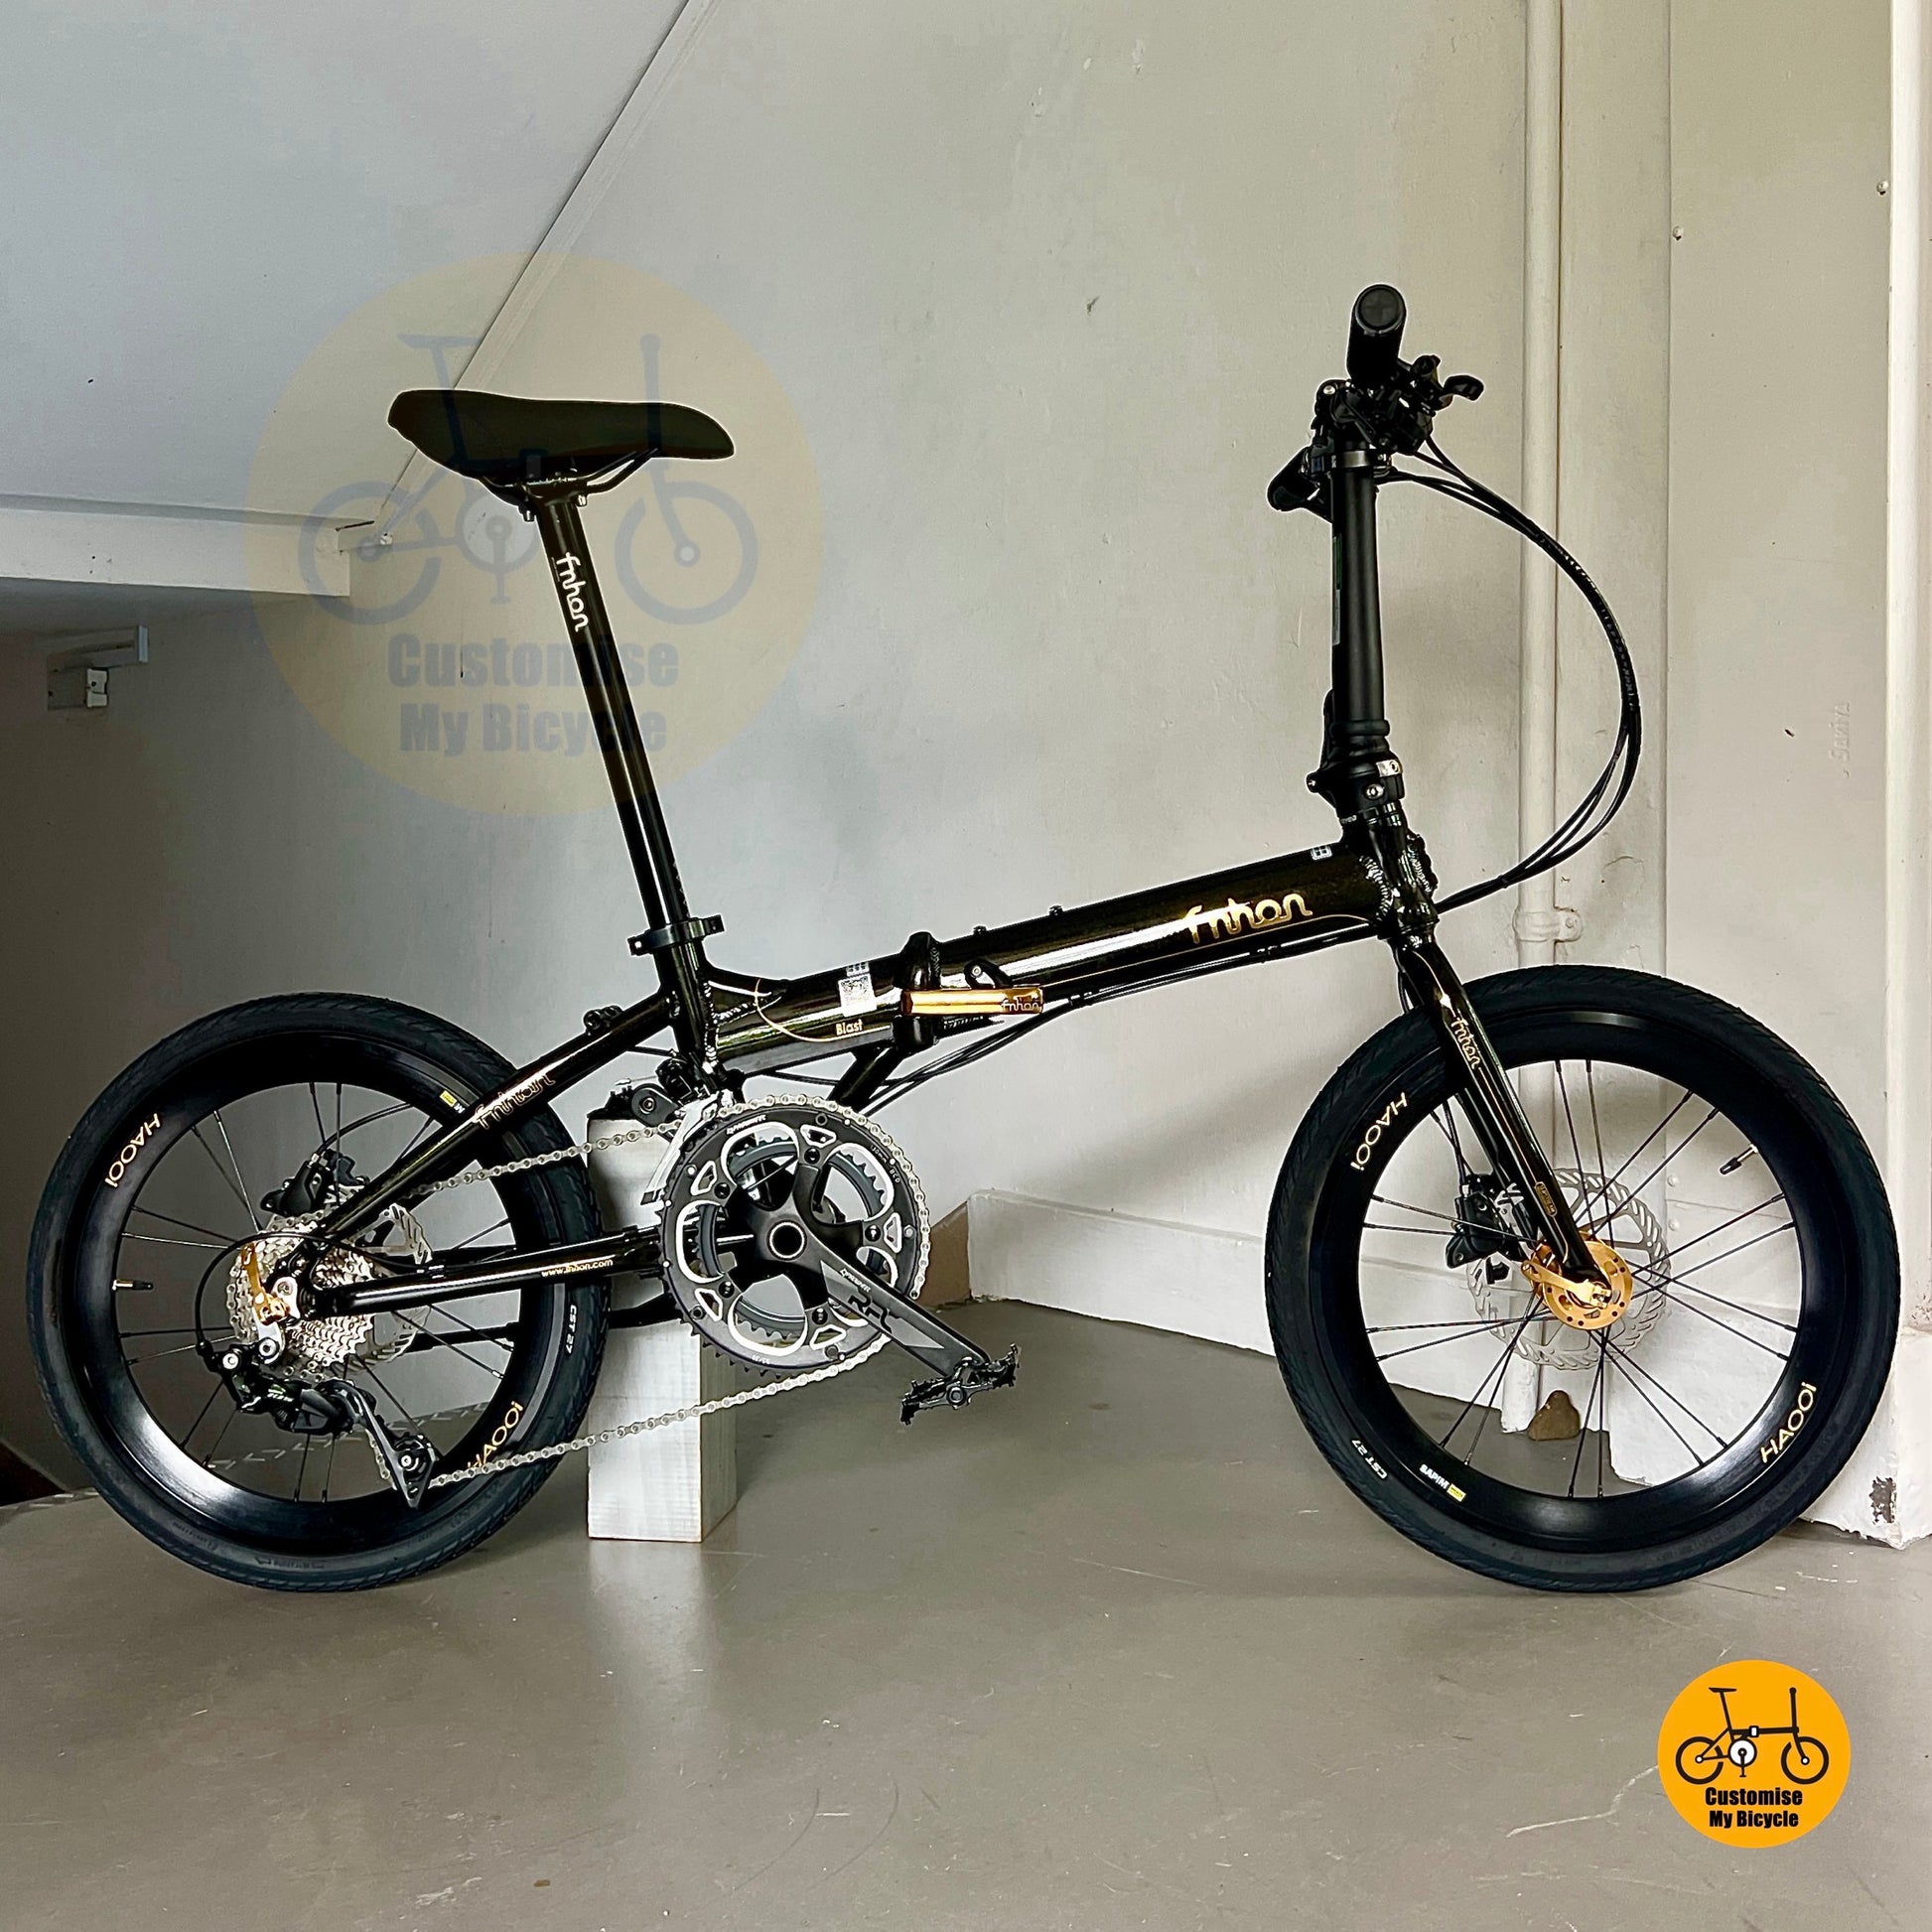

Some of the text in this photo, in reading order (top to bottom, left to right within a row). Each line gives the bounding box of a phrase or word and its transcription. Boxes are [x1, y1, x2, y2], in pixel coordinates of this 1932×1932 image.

[556, 551, 589, 632] fnhon
[835, 1019, 863, 1036] Blast
[1450, 1017, 1481, 1070] fnhon
[565, 1304, 578, 1354] CST 27
[1351, 1439, 1388, 1479] CST 27
[1419, 1463, 1449, 1489] SAPIM
